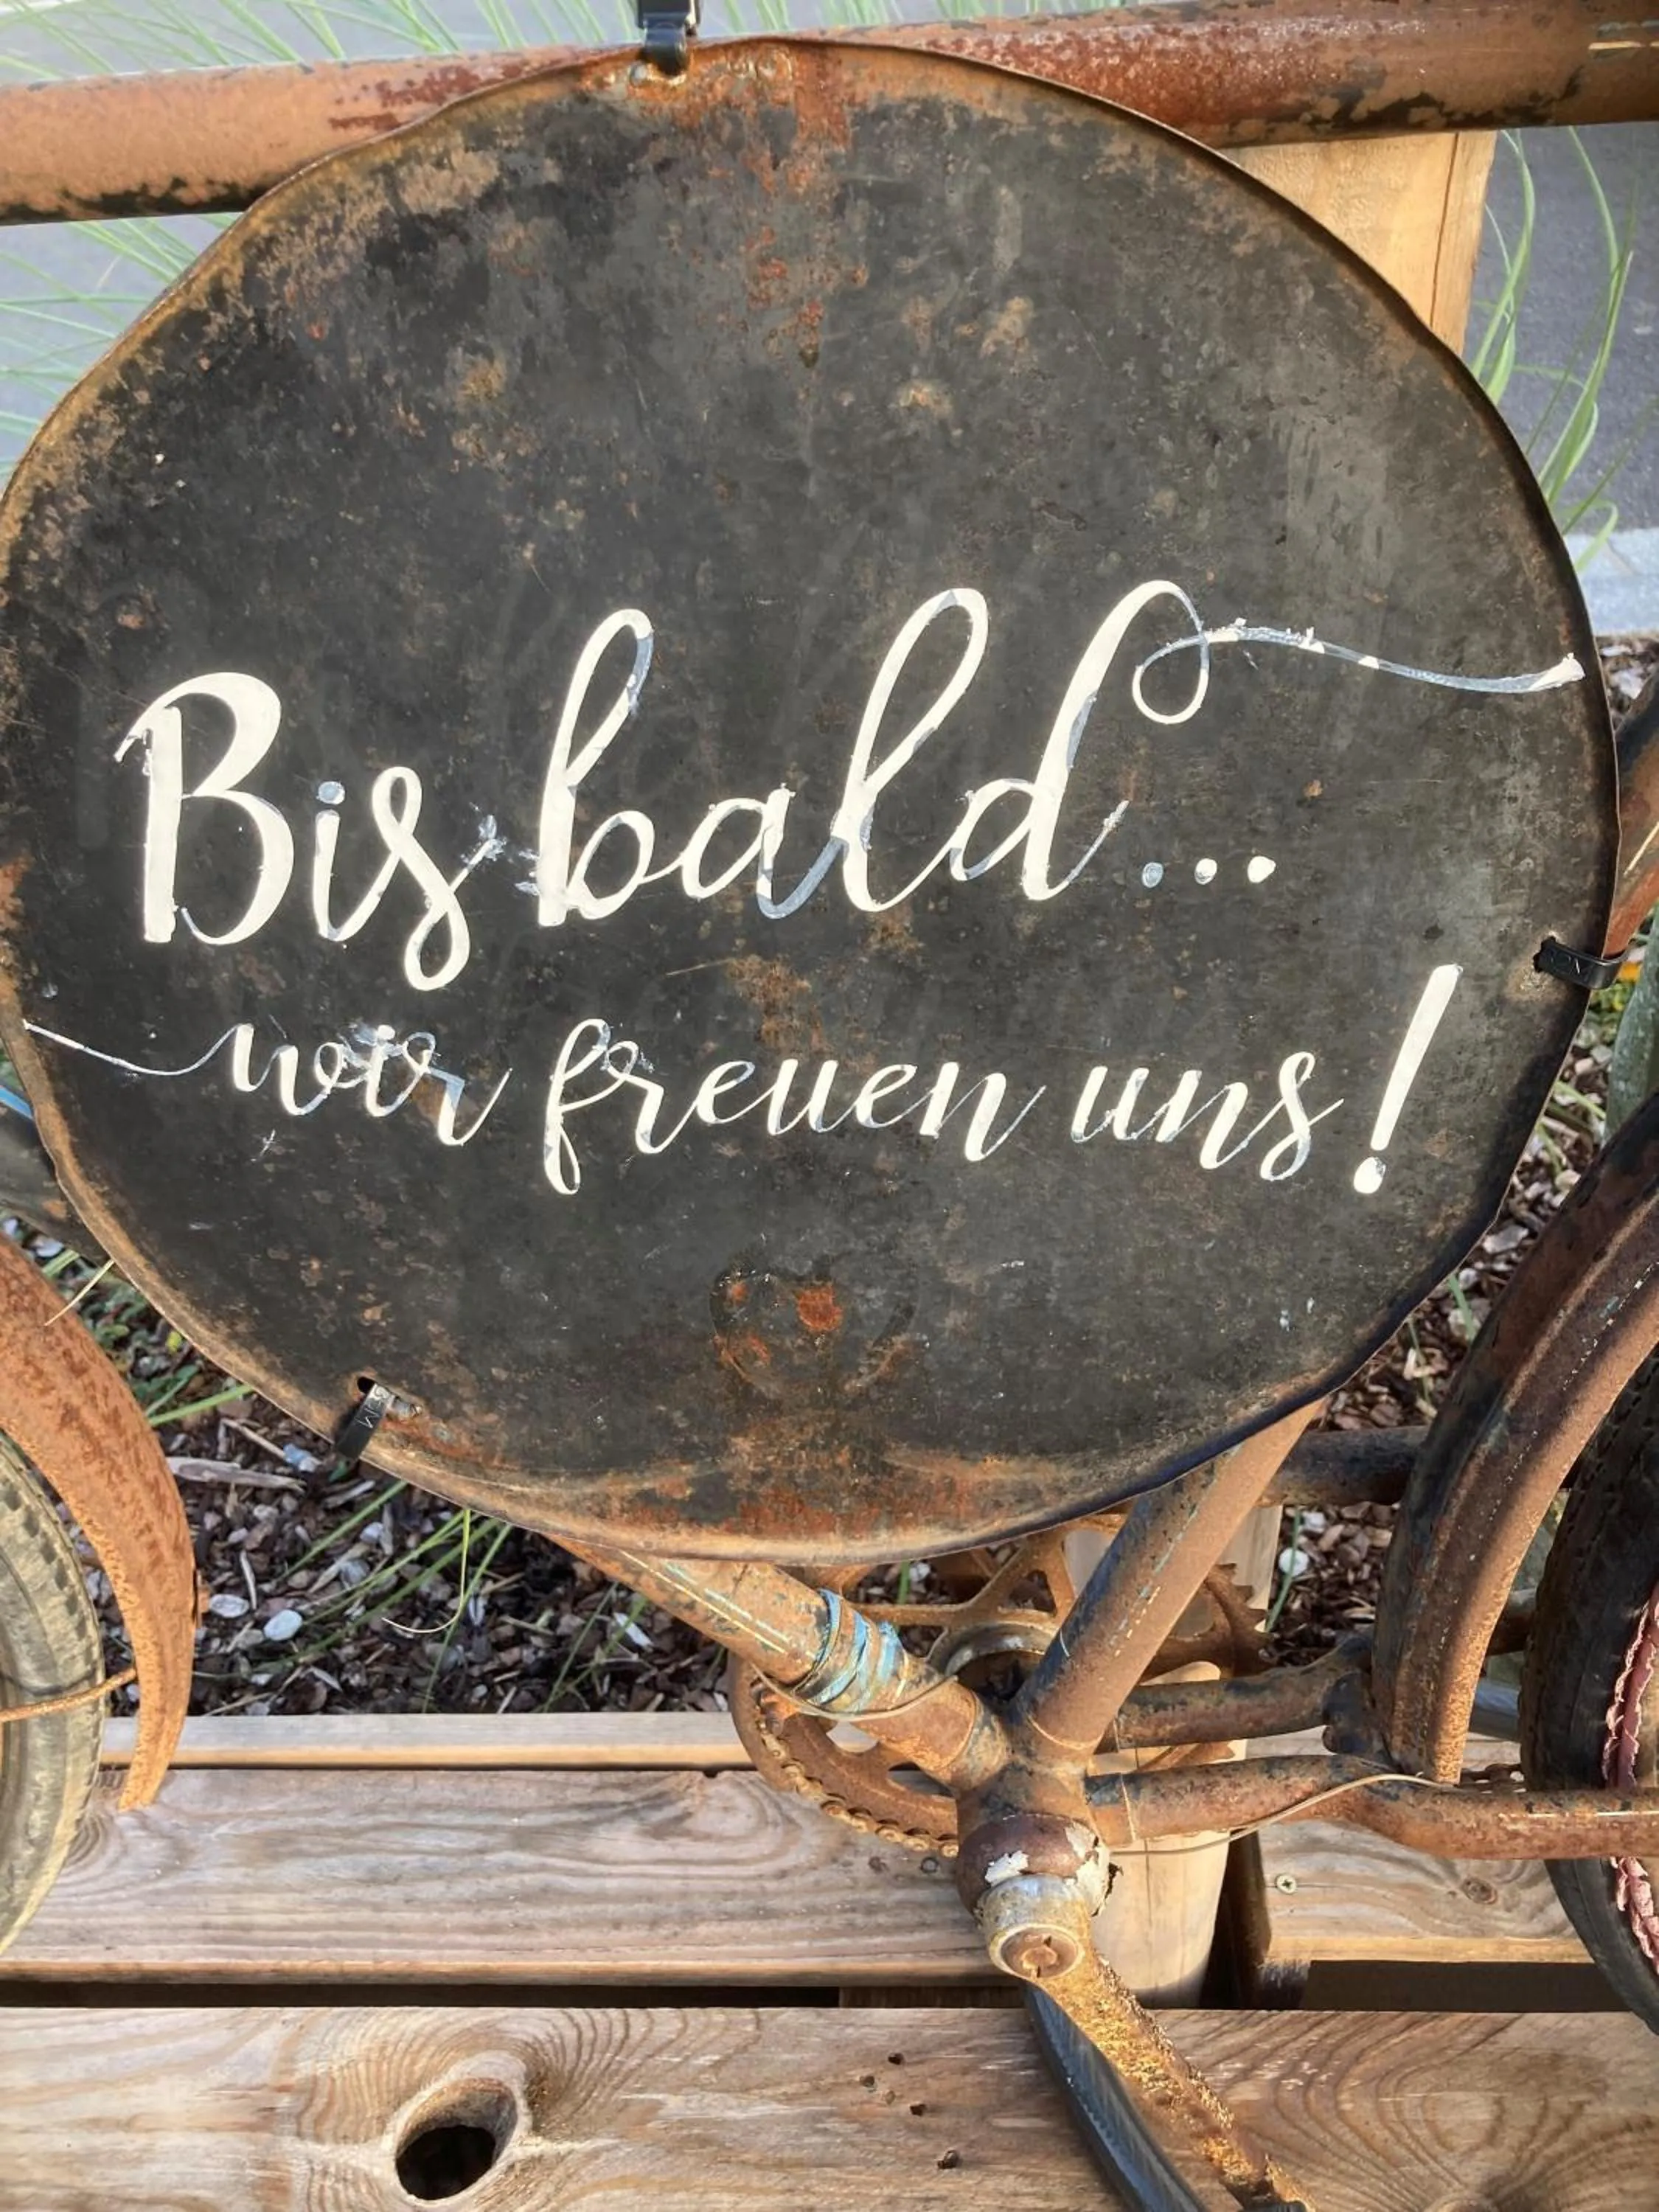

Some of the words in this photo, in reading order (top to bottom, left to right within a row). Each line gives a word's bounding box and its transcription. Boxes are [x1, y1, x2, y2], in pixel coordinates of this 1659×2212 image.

[114, 672, 504, 992] Bis
[23, 1018, 513, 1147] wir
[543, 1018, 1047, 1195] freuen
